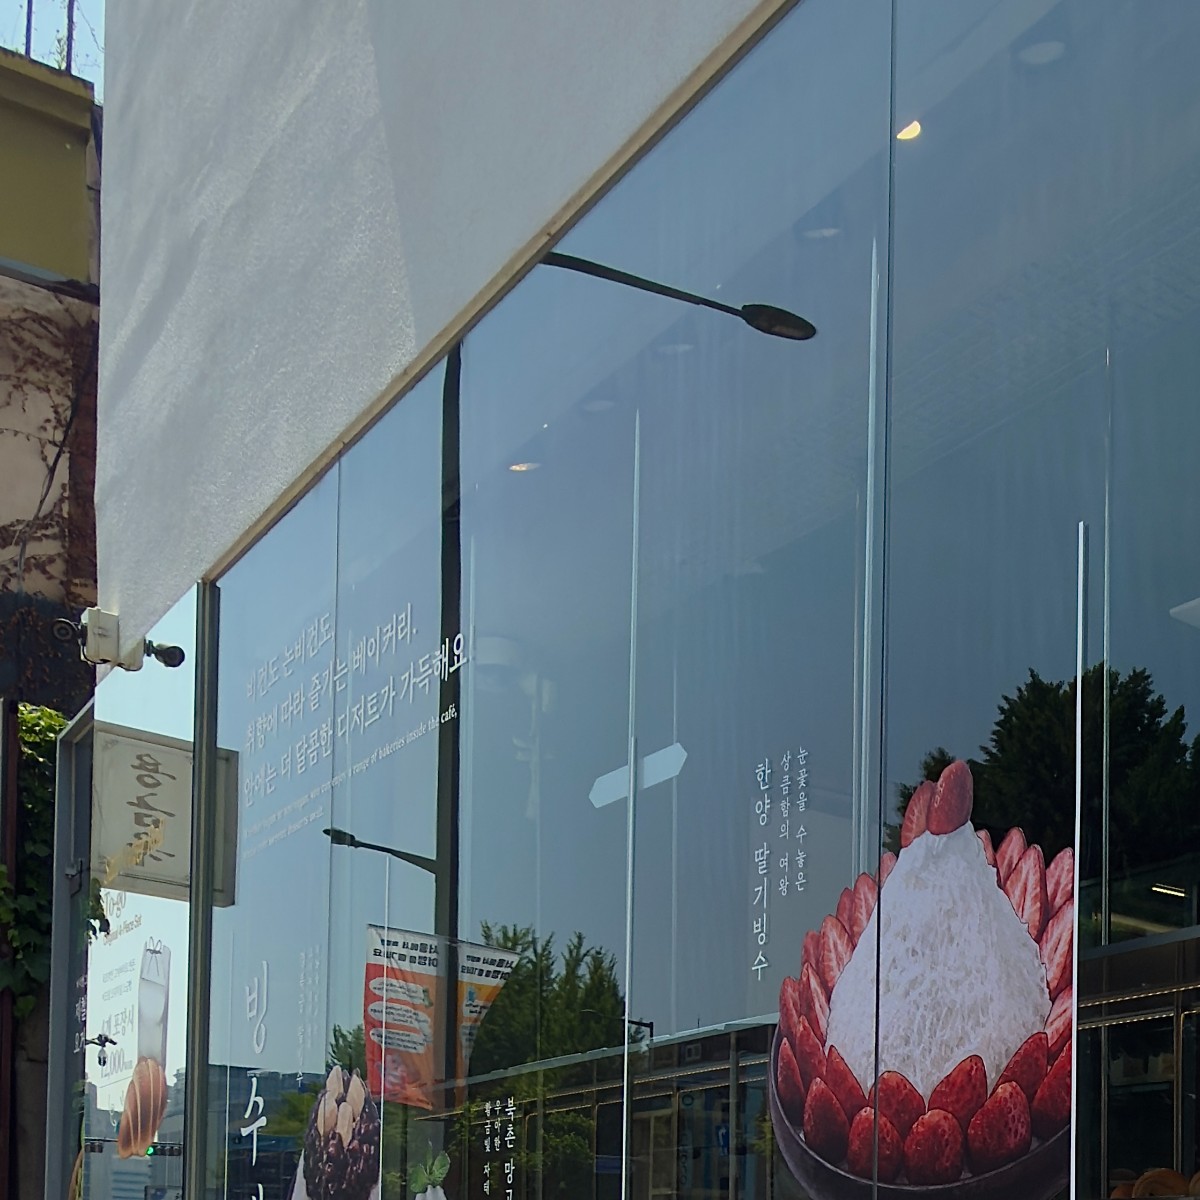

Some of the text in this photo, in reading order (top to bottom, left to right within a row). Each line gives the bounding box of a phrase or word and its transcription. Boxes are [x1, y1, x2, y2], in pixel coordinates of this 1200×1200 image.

[246, 602, 418, 755] 취향에 따라 즐기는 베이커리.
[246, 656, 280, 702] 비건도
[244, 762, 277, 808] 안에는
[281, 745, 292, 781] 더
[296, 717, 333, 775] 달콤한
[338, 676, 396, 744] 디저트가
[378, 738, 405, 762] bakeries
[406, 725, 426, 746] inside
[440, 704, 458, 724] café,
[778, 750, 792, 897] 상큼함의 여왕
[795, 745, 809, 893] 눈꽃을 수놓은
[750, 758, 772, 983] 한양 딸기빙수
[494, 1099, 502, 1152] 우아한
[504, 1095, 517, 1149] 북촌
[483, 1161, 491, 1196] 자태
